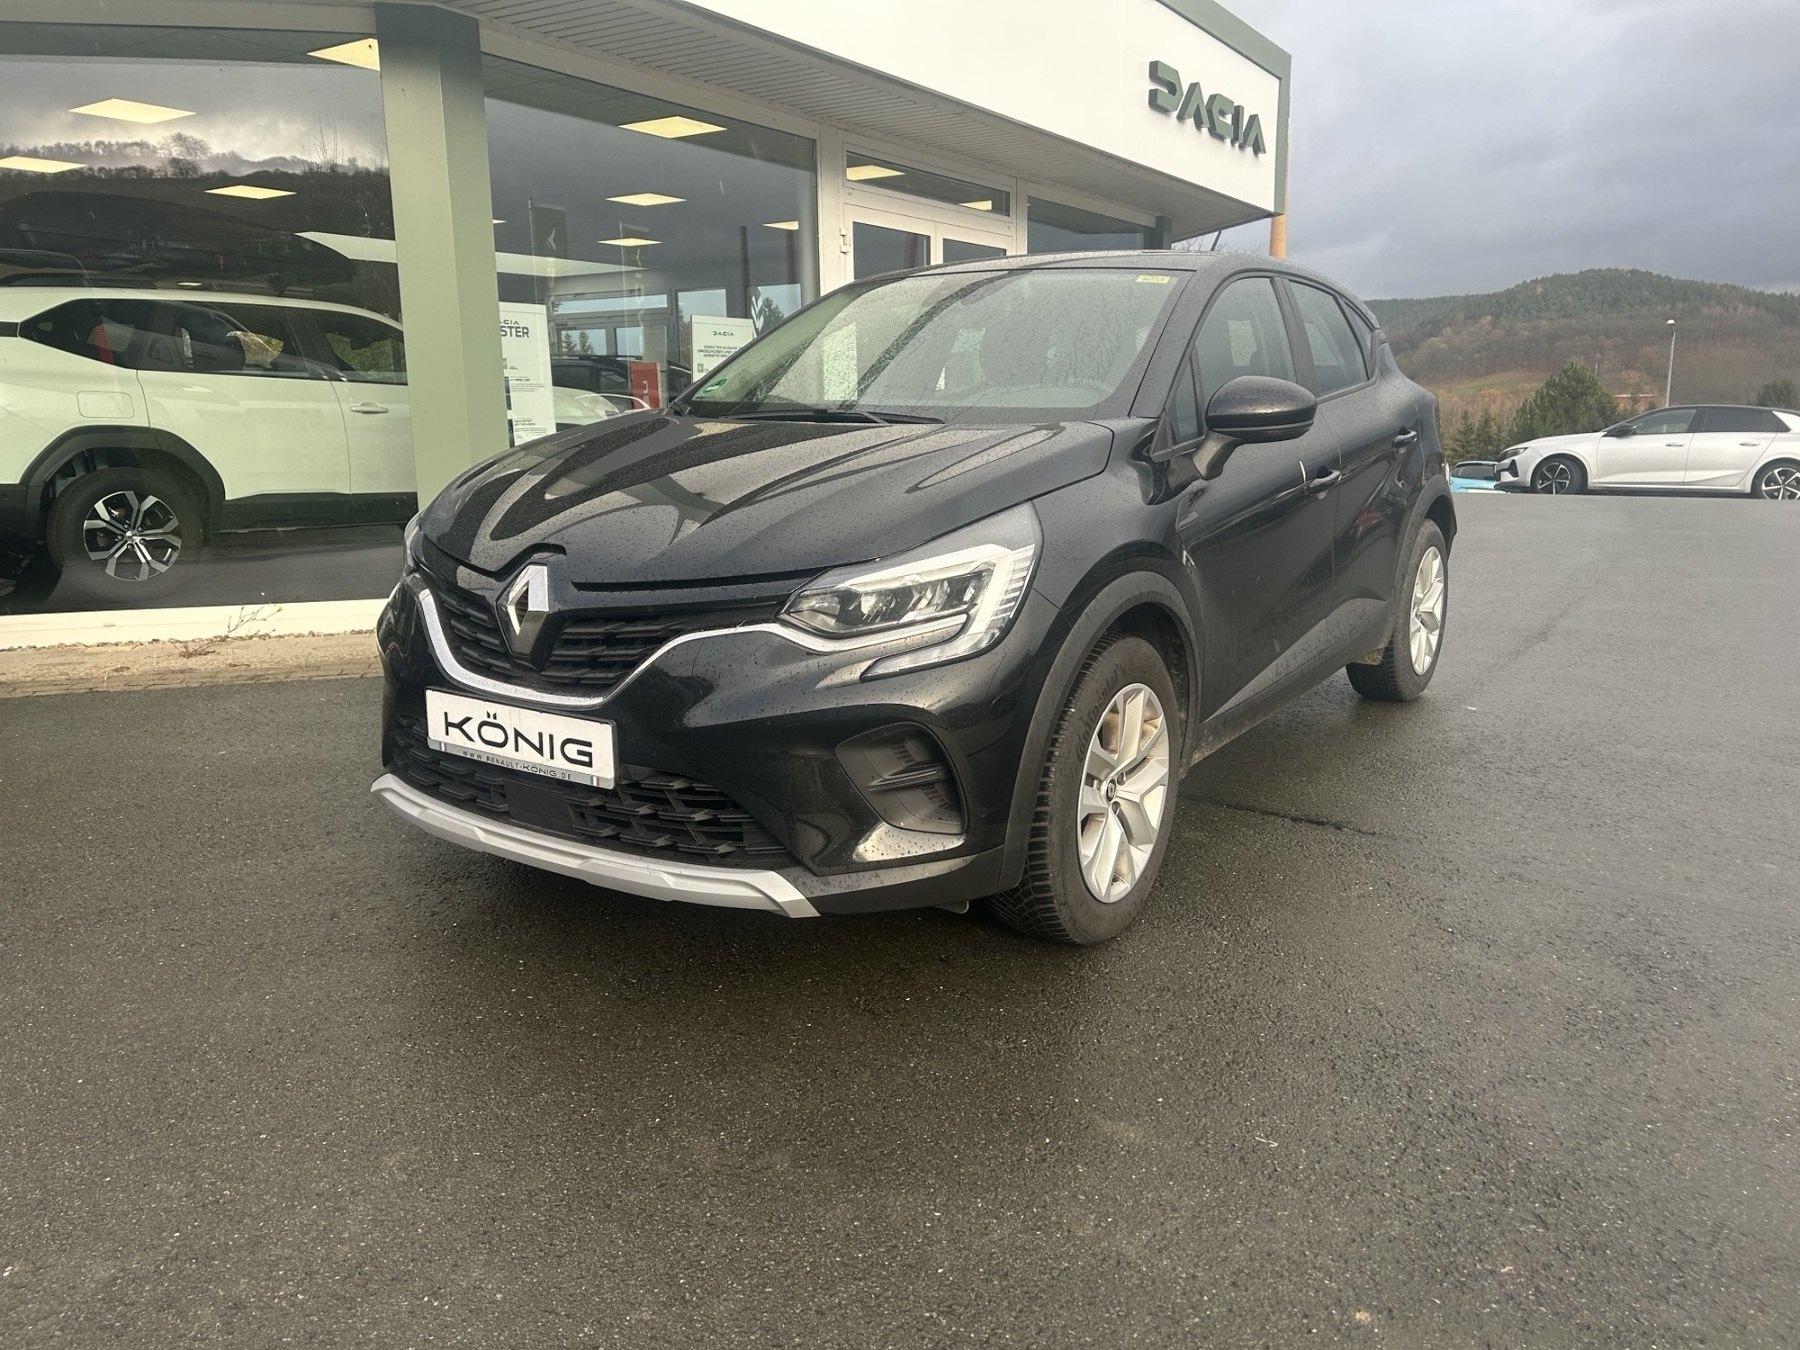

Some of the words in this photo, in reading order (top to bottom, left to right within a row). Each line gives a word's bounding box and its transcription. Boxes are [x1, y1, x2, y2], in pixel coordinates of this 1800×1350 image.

[1148, 60, 1266, 157] DACIA
[500, 325, 530, 338] STER
[444, 711, 593, 768] KÖNIG
